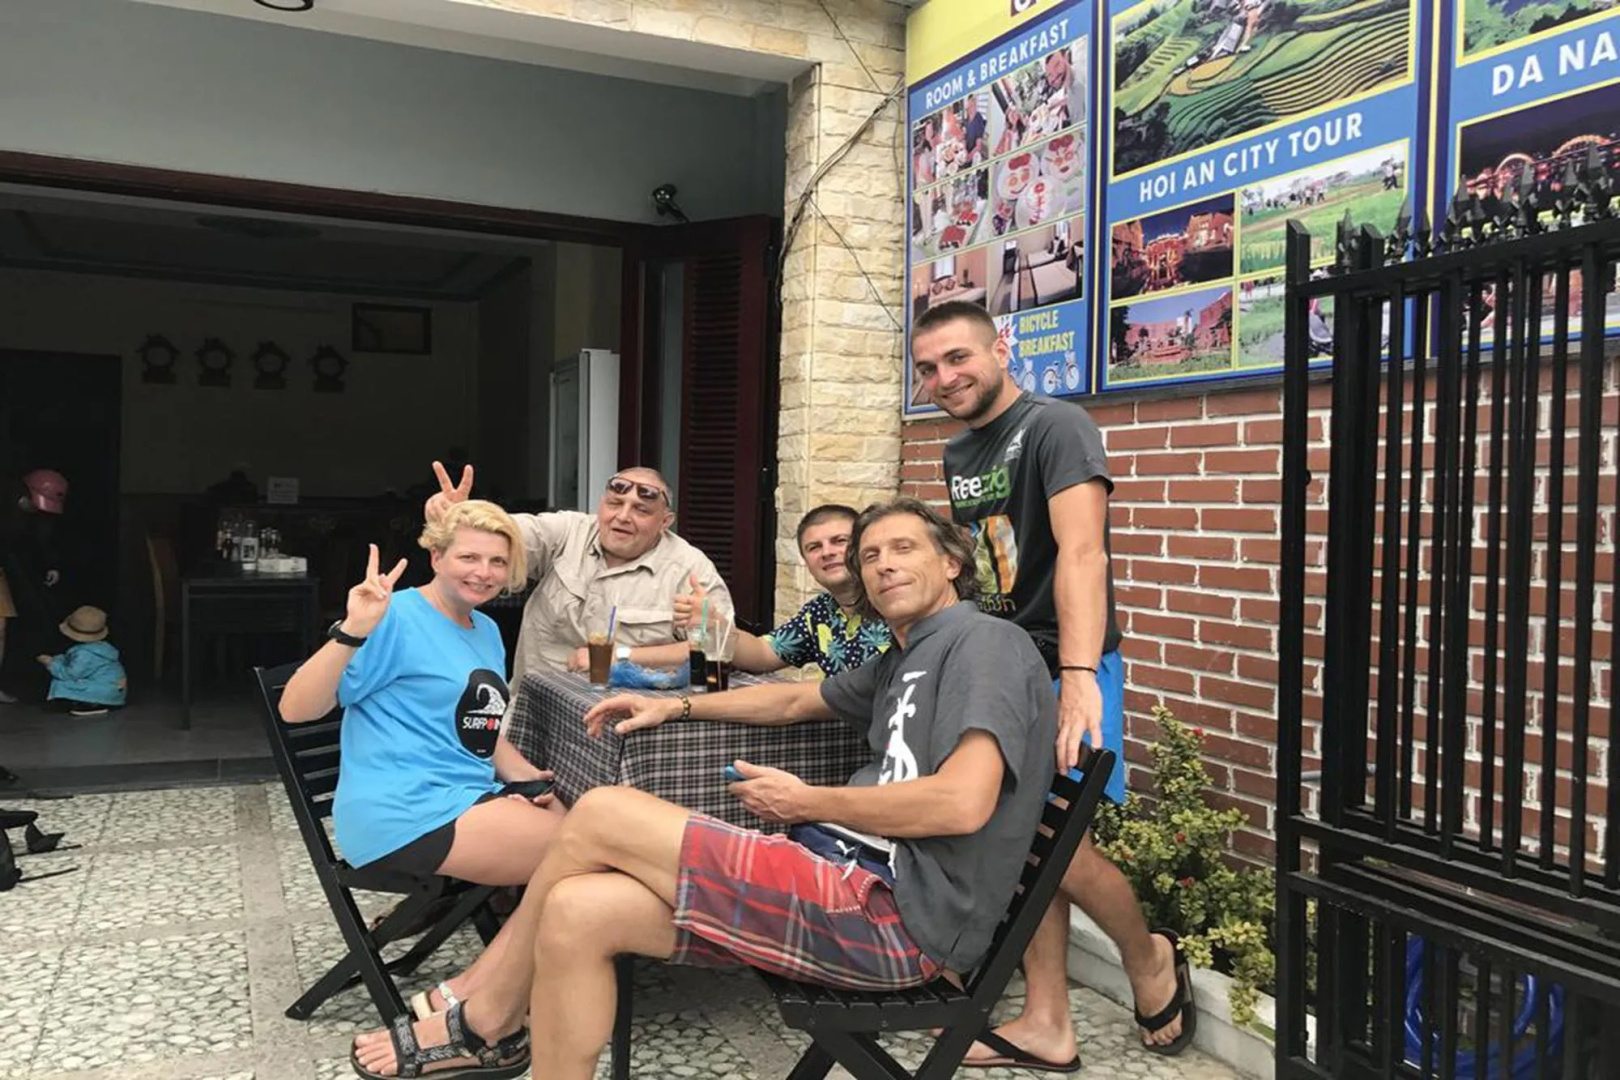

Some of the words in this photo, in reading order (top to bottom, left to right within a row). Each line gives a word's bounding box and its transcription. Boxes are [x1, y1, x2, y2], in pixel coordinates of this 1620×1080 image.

[925, 77, 964, 110] ROOM
[966, 71, 977, 88] &
[980, 19, 1069, 80] BREAKFAST
[1492, 54, 1544, 96] DA
[1139, 171, 1176, 202] HOI
[1183, 160, 1215, 190] AN
[1223, 138, 1281, 177] CITY
[1288, 112, 1363, 157] TOUR
[1018, 310, 1059, 334] BICYCLE
[1018, 331, 1075, 358] BREAKFAST
